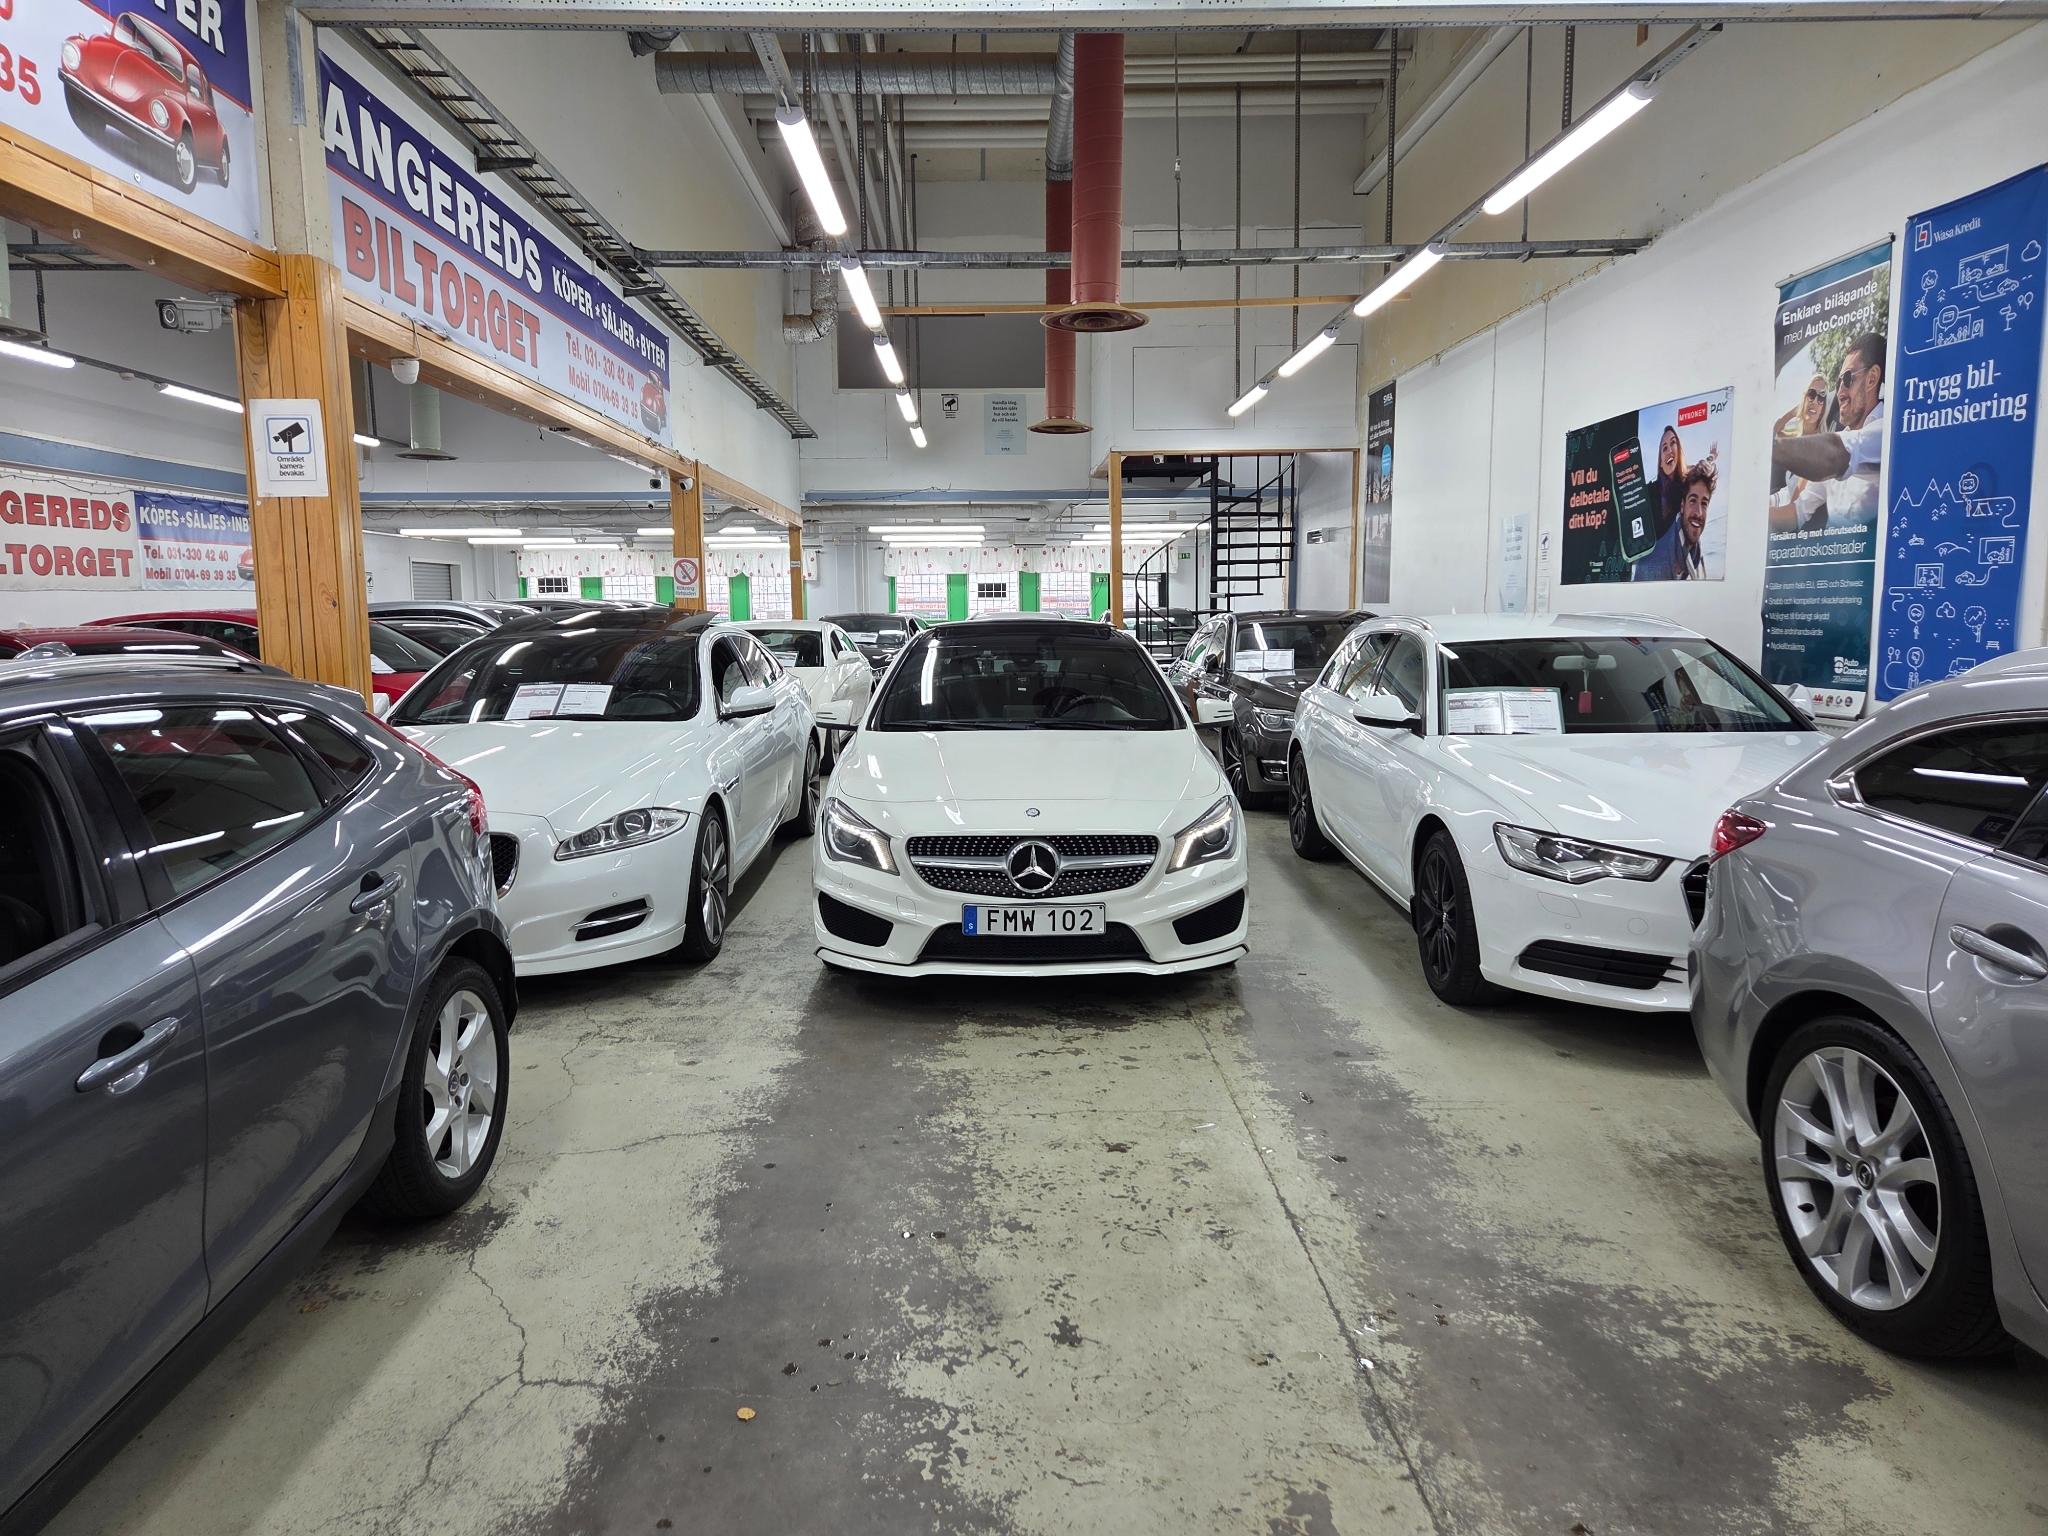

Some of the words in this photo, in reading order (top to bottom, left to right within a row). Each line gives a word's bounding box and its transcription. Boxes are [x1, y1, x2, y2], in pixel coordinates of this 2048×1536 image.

[154, 0, 226, 56] ER
[323, 80, 544, 295] ANGEREDS
[1933, 228, 1954, 243] Wasa
[1955, 217, 1981, 237] Kredit
[341, 195, 541, 369] BILTORGET
[1782, 303, 1822, 326] Enklare
[1824, 280, 1878, 312] bilägande
[552, 265, 594, 319] KÖPER
[601, 302, 635, 349] SÄLJER
[640, 333, 666, 372] BYTER
[1783, 327, 1803, 346] med
[1804, 301, 1875, 338] AutoConcept
[565, 331, 582, 361] Tel.
[616, 365, 626, 387] 42
[627, 371, 635, 392] 40
[568, 364, 591, 395] Mobil
[630, 400, 639, 420] 35
[1904, 371, 1963, 405] Trygg
[1966, 358, 2002, 387] bil-
[1679, 408, 1706, 422] MYMONEY
[1710, 400, 1728, 415] PAY
[1901, 391, 2029, 434] finansiering
[276, 455, 305, 463] Området
[1570, 469, 1585, 487] Vill
[1586, 467, 1598, 484] du
[1569, 486, 1611, 508] delbetala
[0, 490, 131, 532] GEREDS
[139, 504, 180, 527] KÖPES
[185, 509, 227, 531] SÄLJES
[231, 515, 251, 532] INB
[1568, 513, 1584, 530] ditt
[1585, 508, 1608, 530] köp?
[1769, 531, 1797, 542] Försäkra
[1797, 529, 1808, 540] dig
[1809, 528, 1823, 538] mot
[1824, 524, 1868, 536] oförutsedda
[143, 544, 164, 560] Tel.
[167, 546, 202, 561] 031-330
[205, 549, 216, 562] 42
[218, 550, 229, 562] 40
[1768, 540, 1866, 562] reparationskostnader
[145, 567, 171, 580] Mobil
[213, 569, 224, 581] 39
[226, 570, 237, 581] 35
[1782, 582, 1795, 590] inom
[1828, 580, 1840, 588] och
[1839, 579, 1864, 588] Schweiz
[1784, 597, 1793, 605] och
[1843, 658, 1860, 667] Auto
[1843, 666, 1868, 677] Concept
[968, 922, 974, 930] S
[987, 909, 1036, 932] FMW
[1047, 909, 1093, 932] 102
